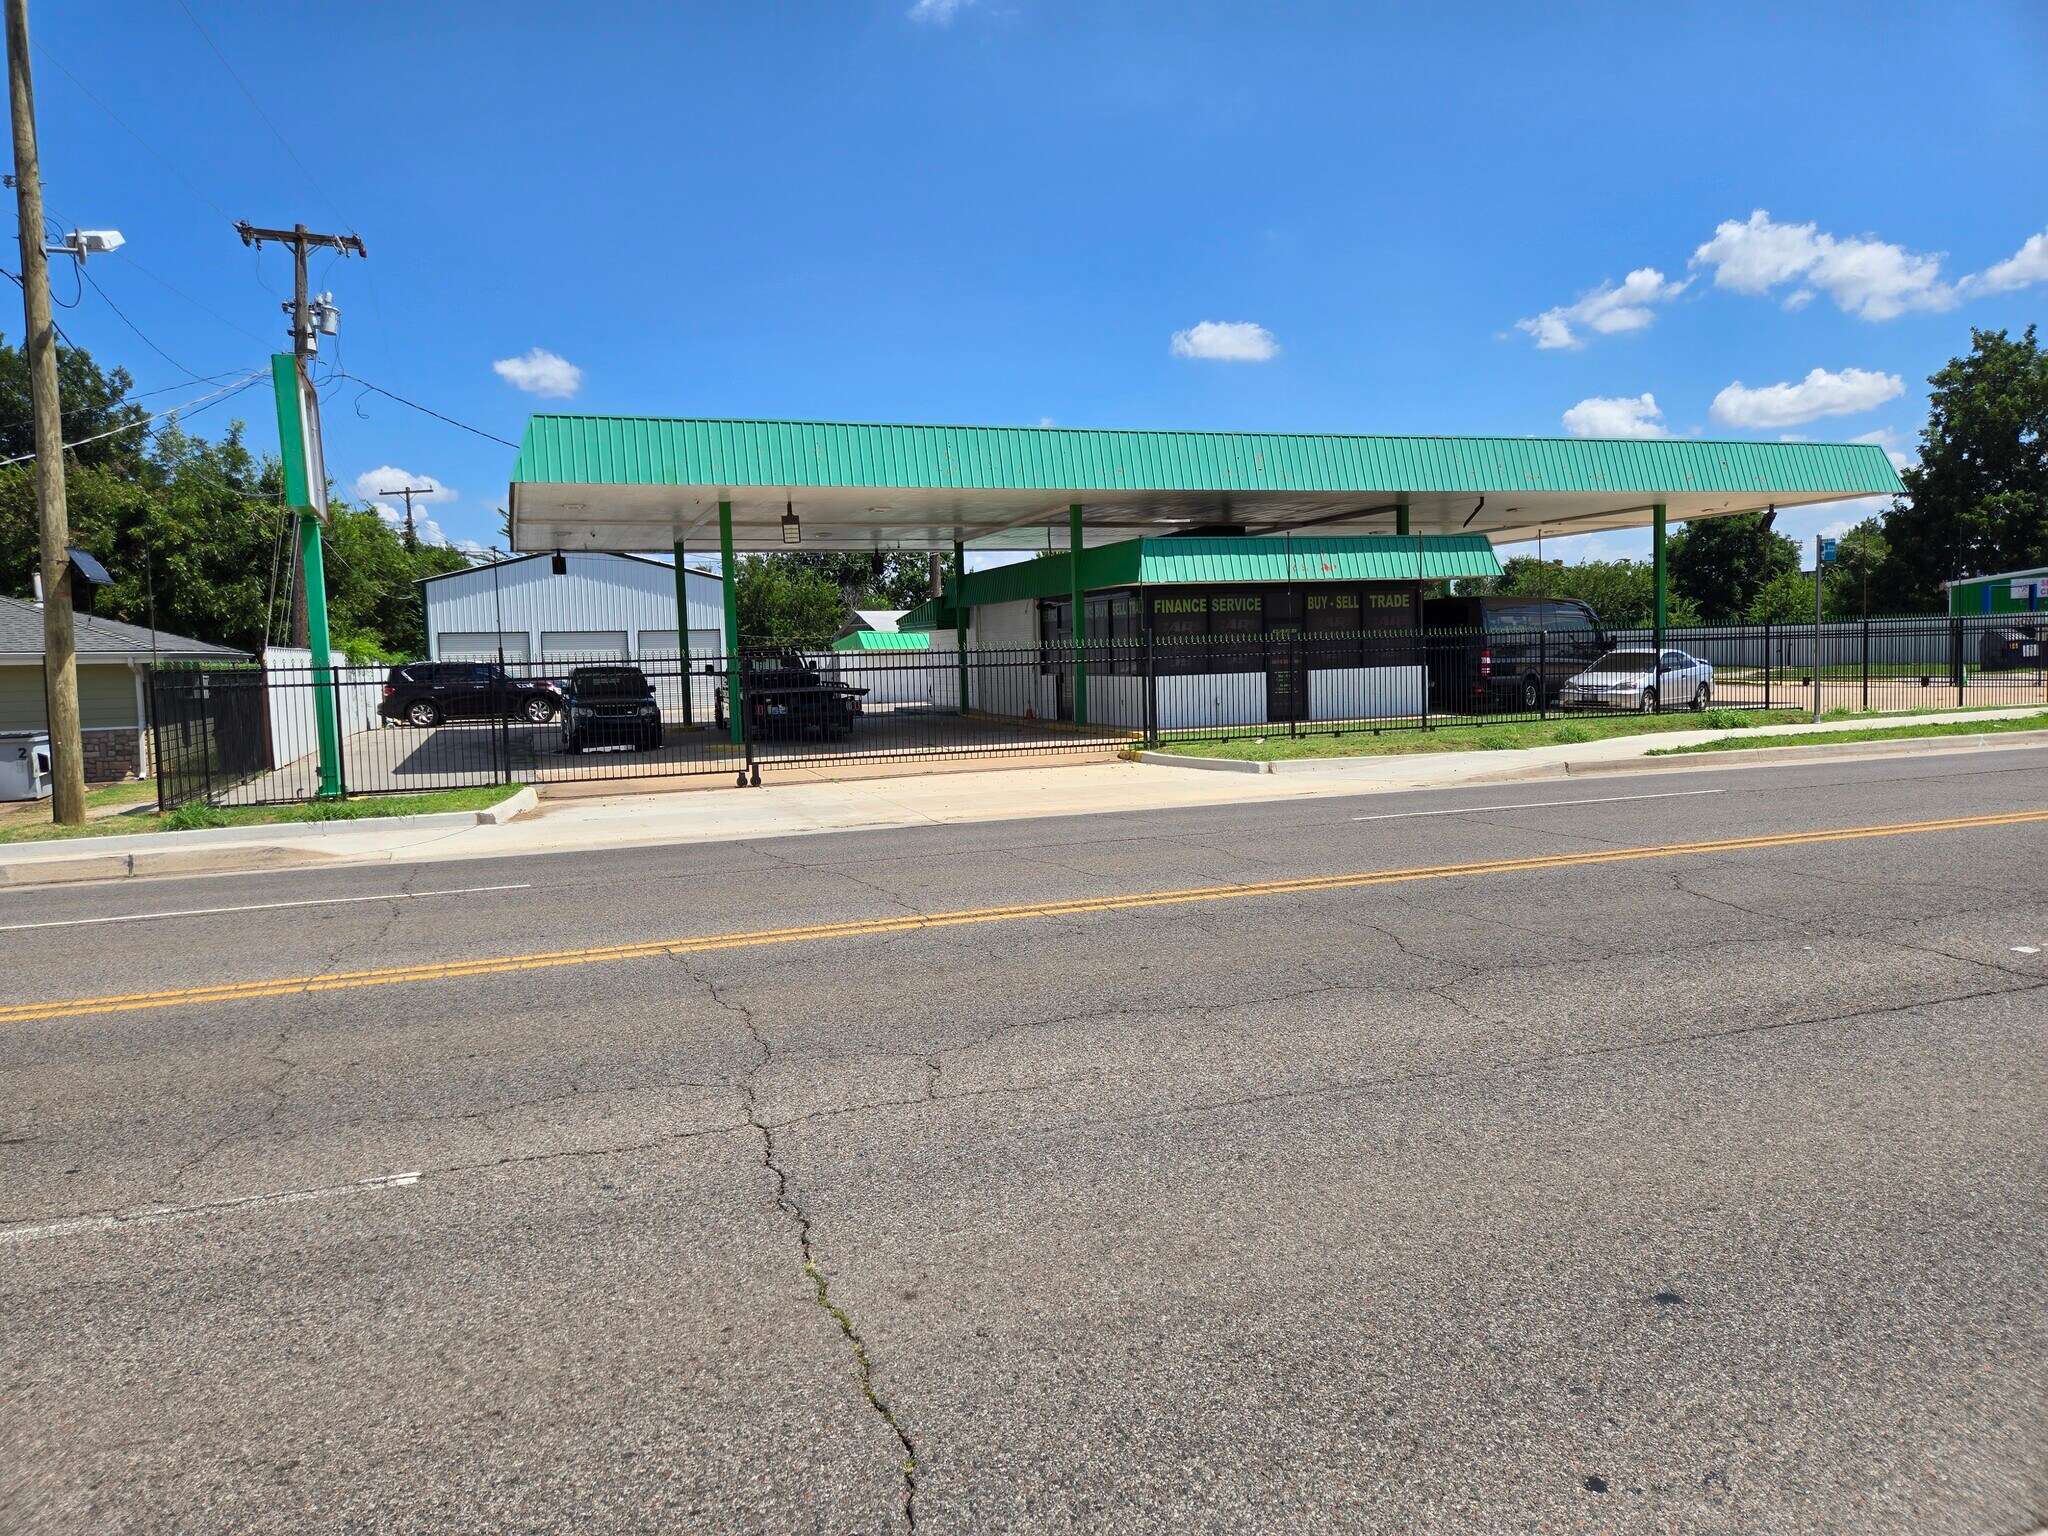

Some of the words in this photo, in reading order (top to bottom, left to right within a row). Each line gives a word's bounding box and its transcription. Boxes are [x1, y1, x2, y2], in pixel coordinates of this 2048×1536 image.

[1154, 599, 1207, 613] FINANCE
[1211, 598, 1261, 611] SERVICE
[1307, 596, 1328, 609] BUY
[1336, 595, 1359, 609] SELL
[1370, 594, 1410, 608] TRADE
[1112, 602, 1126, 616] SELL
[18, 747, 27, 759] 2
